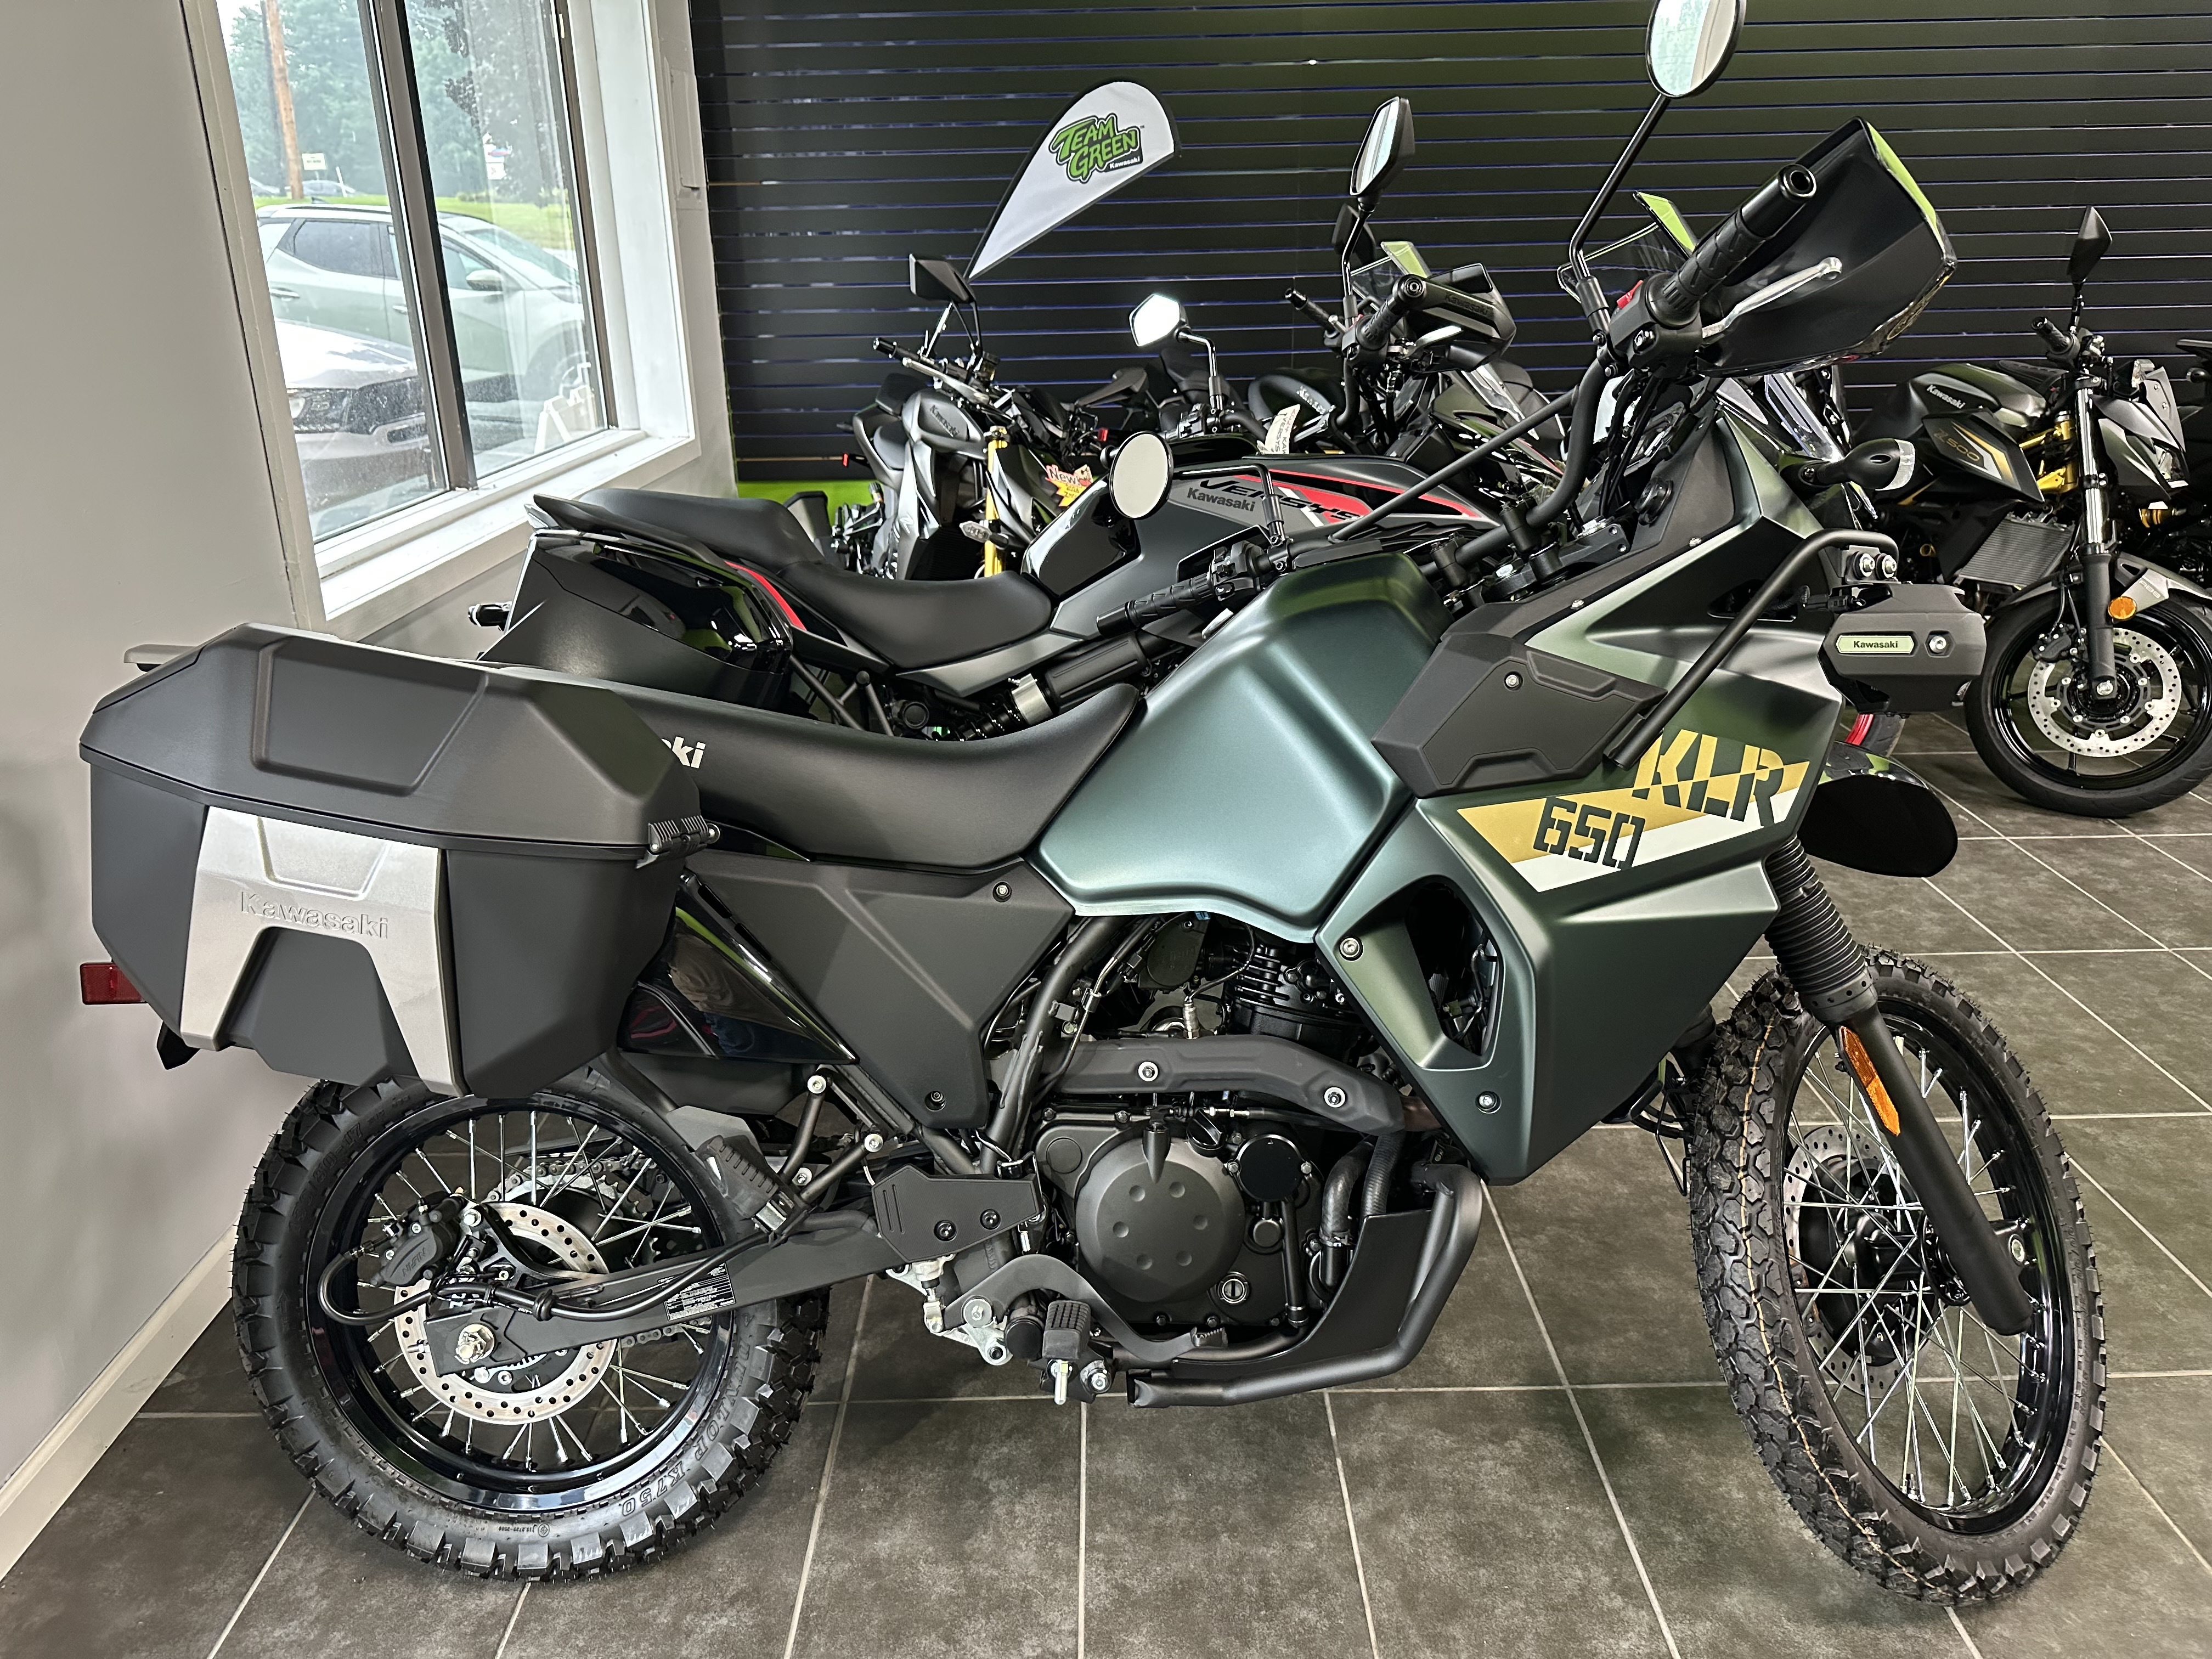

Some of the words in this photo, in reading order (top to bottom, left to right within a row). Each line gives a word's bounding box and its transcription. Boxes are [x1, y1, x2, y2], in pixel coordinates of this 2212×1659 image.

[1052, 116, 1115, 159] TEAM
[1070, 129, 1138, 179] GREEN
[1109, 156, 1141, 169] Kawasaki
[1926, 384, 1966, 409] Kawasaki
[1187, 487, 1256, 512] Kawasaki
[1853, 640, 1898, 648] Kawasaki
[1632, 729, 1784, 827] KLR
[1533, 796, 1646, 871] 650
[241, 891, 388, 939] Kawasaki
[695, 1342, 751, 1461] DUNLOP
[622, 1460, 686, 1517] K750
